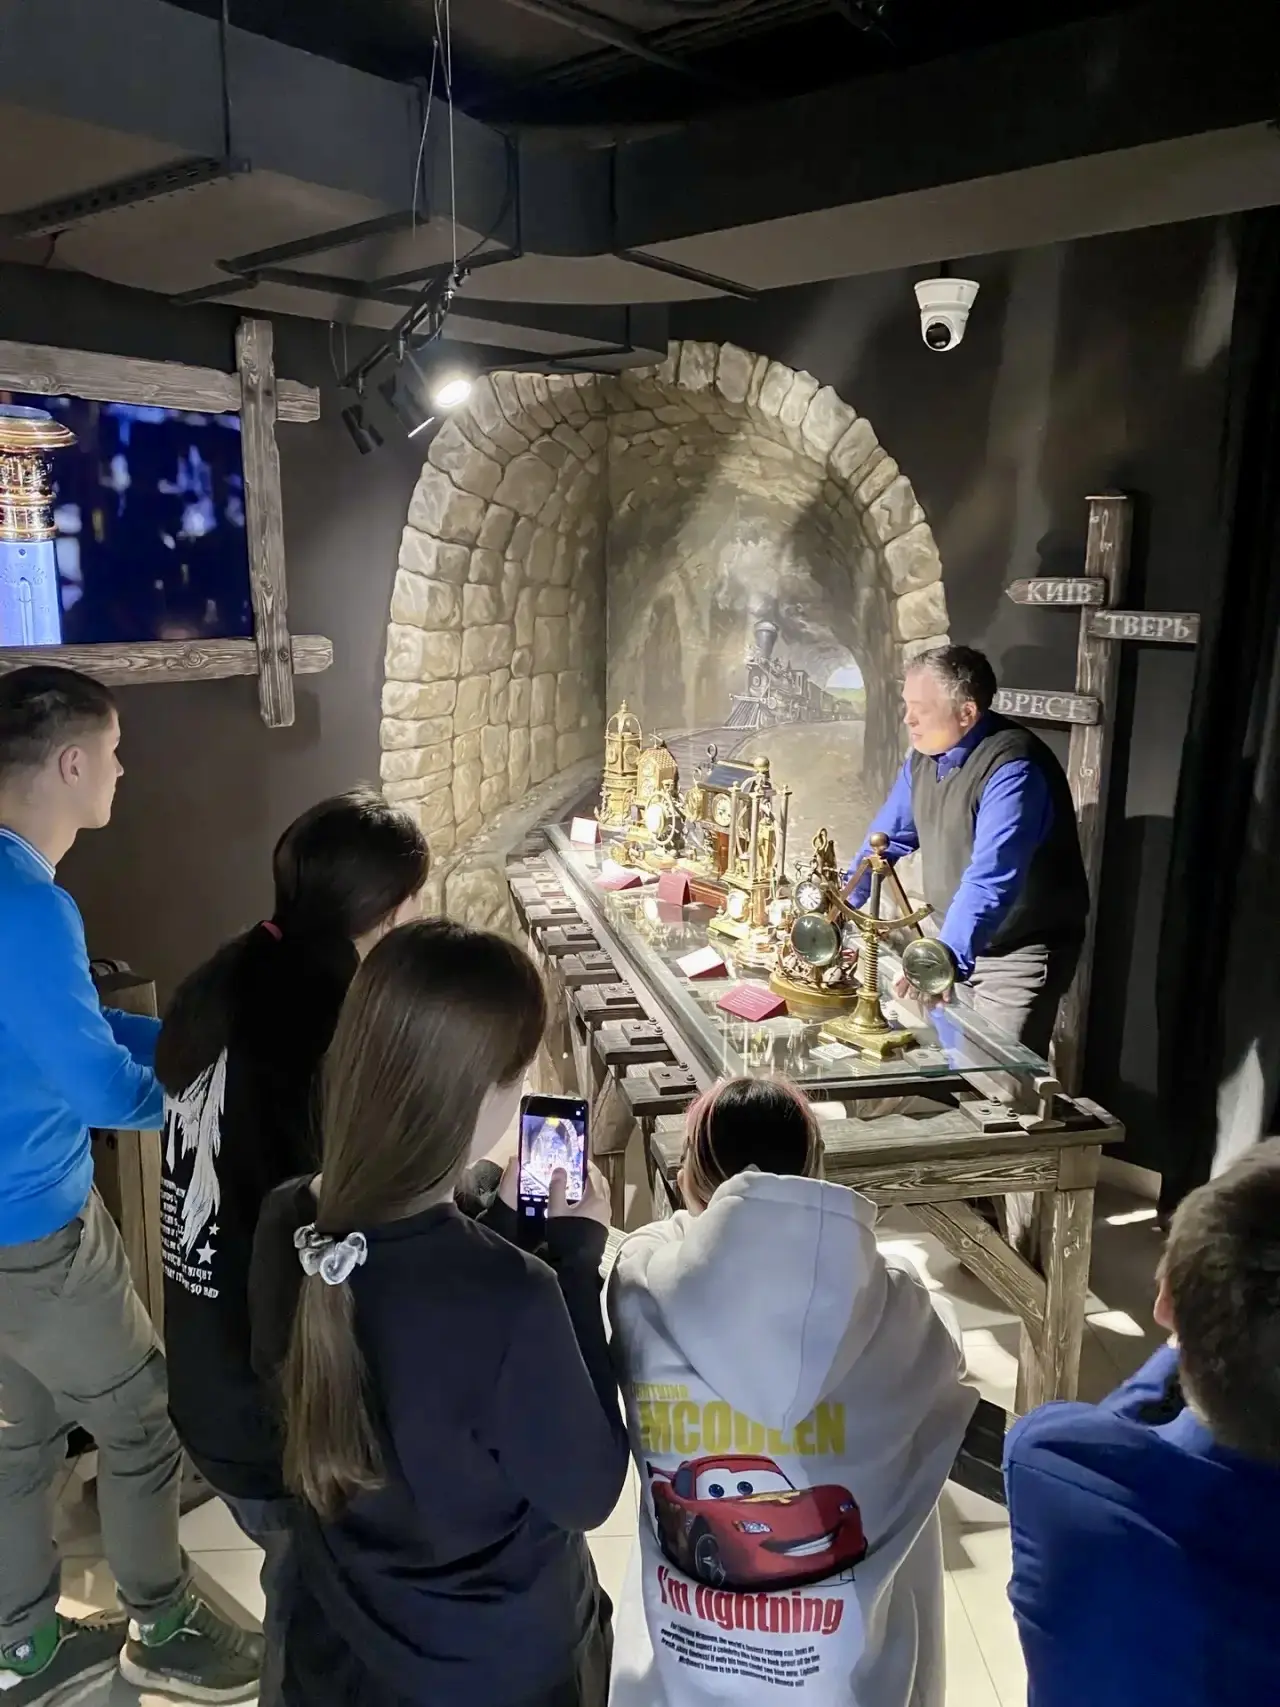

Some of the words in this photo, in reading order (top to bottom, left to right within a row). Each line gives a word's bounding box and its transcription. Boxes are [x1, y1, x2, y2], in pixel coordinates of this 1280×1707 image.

[1027, 578, 1092, 602] КИЇВ
[1104, 615, 1190, 638] ТВЕРЬ
[998, 690, 1083, 719] БРЕСТ
[657, 1565, 692, 1616] I'm
